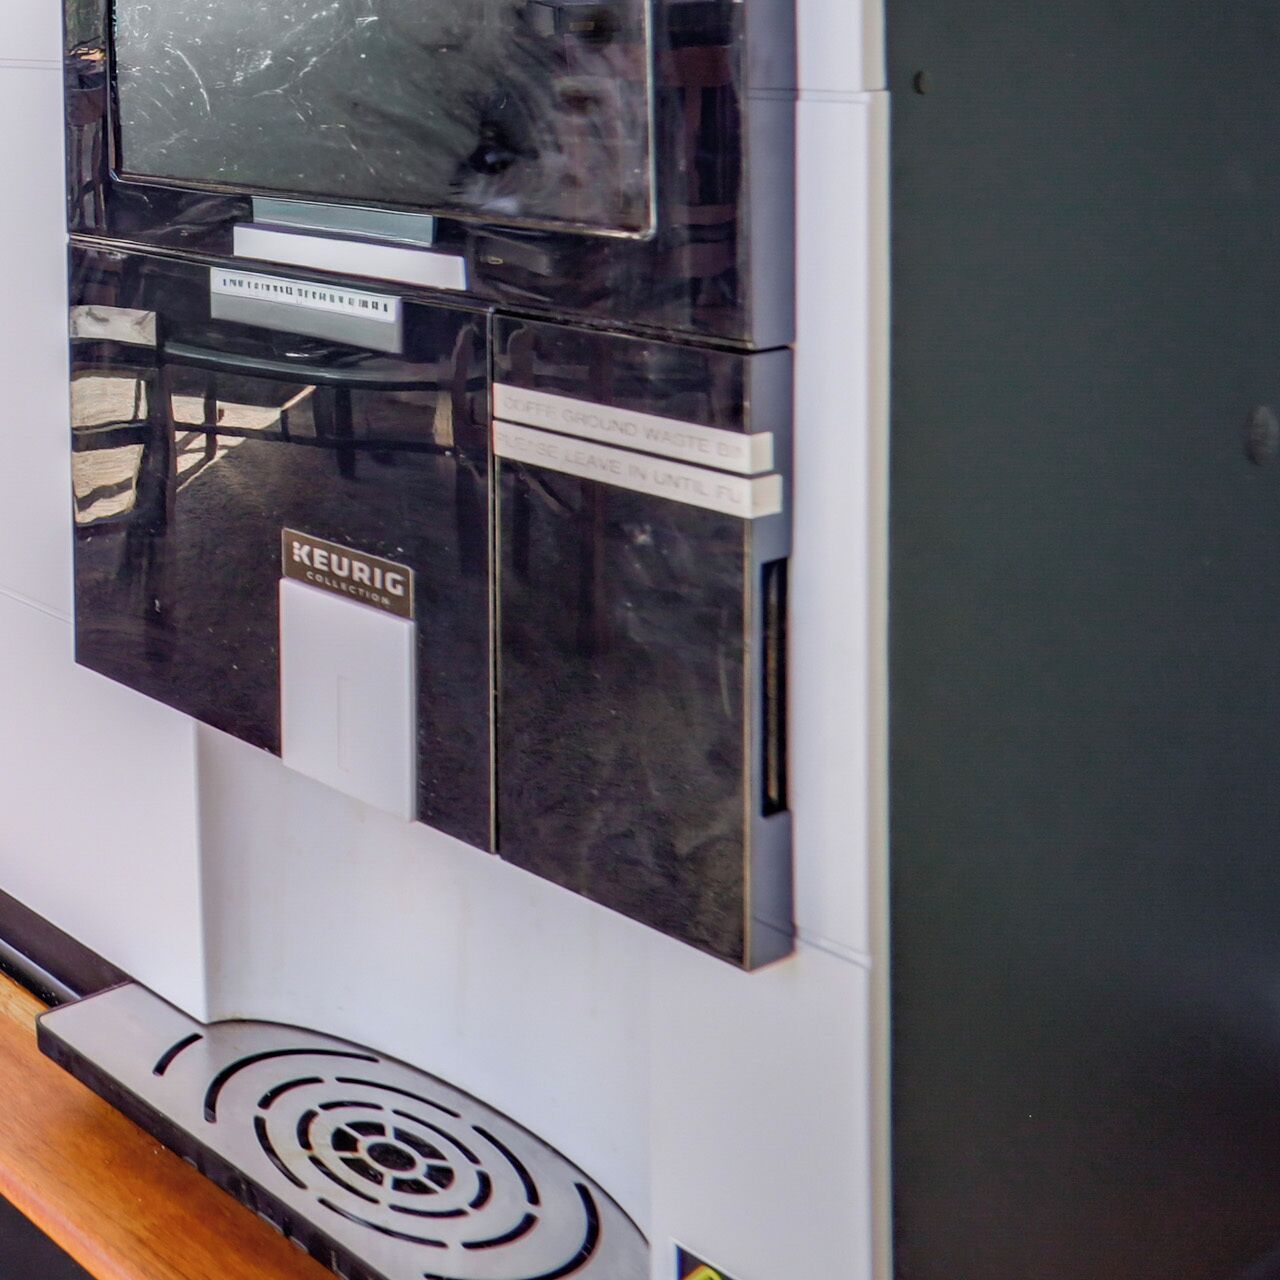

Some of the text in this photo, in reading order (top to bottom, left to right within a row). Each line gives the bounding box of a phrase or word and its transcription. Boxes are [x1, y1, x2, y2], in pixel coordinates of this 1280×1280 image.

[562, 408, 638, 438] GROUND
[564, 450, 621, 474] LEAVE
[292, 541, 405, 597] KEURIG
[306, 570, 391, 605] COLLECTION
